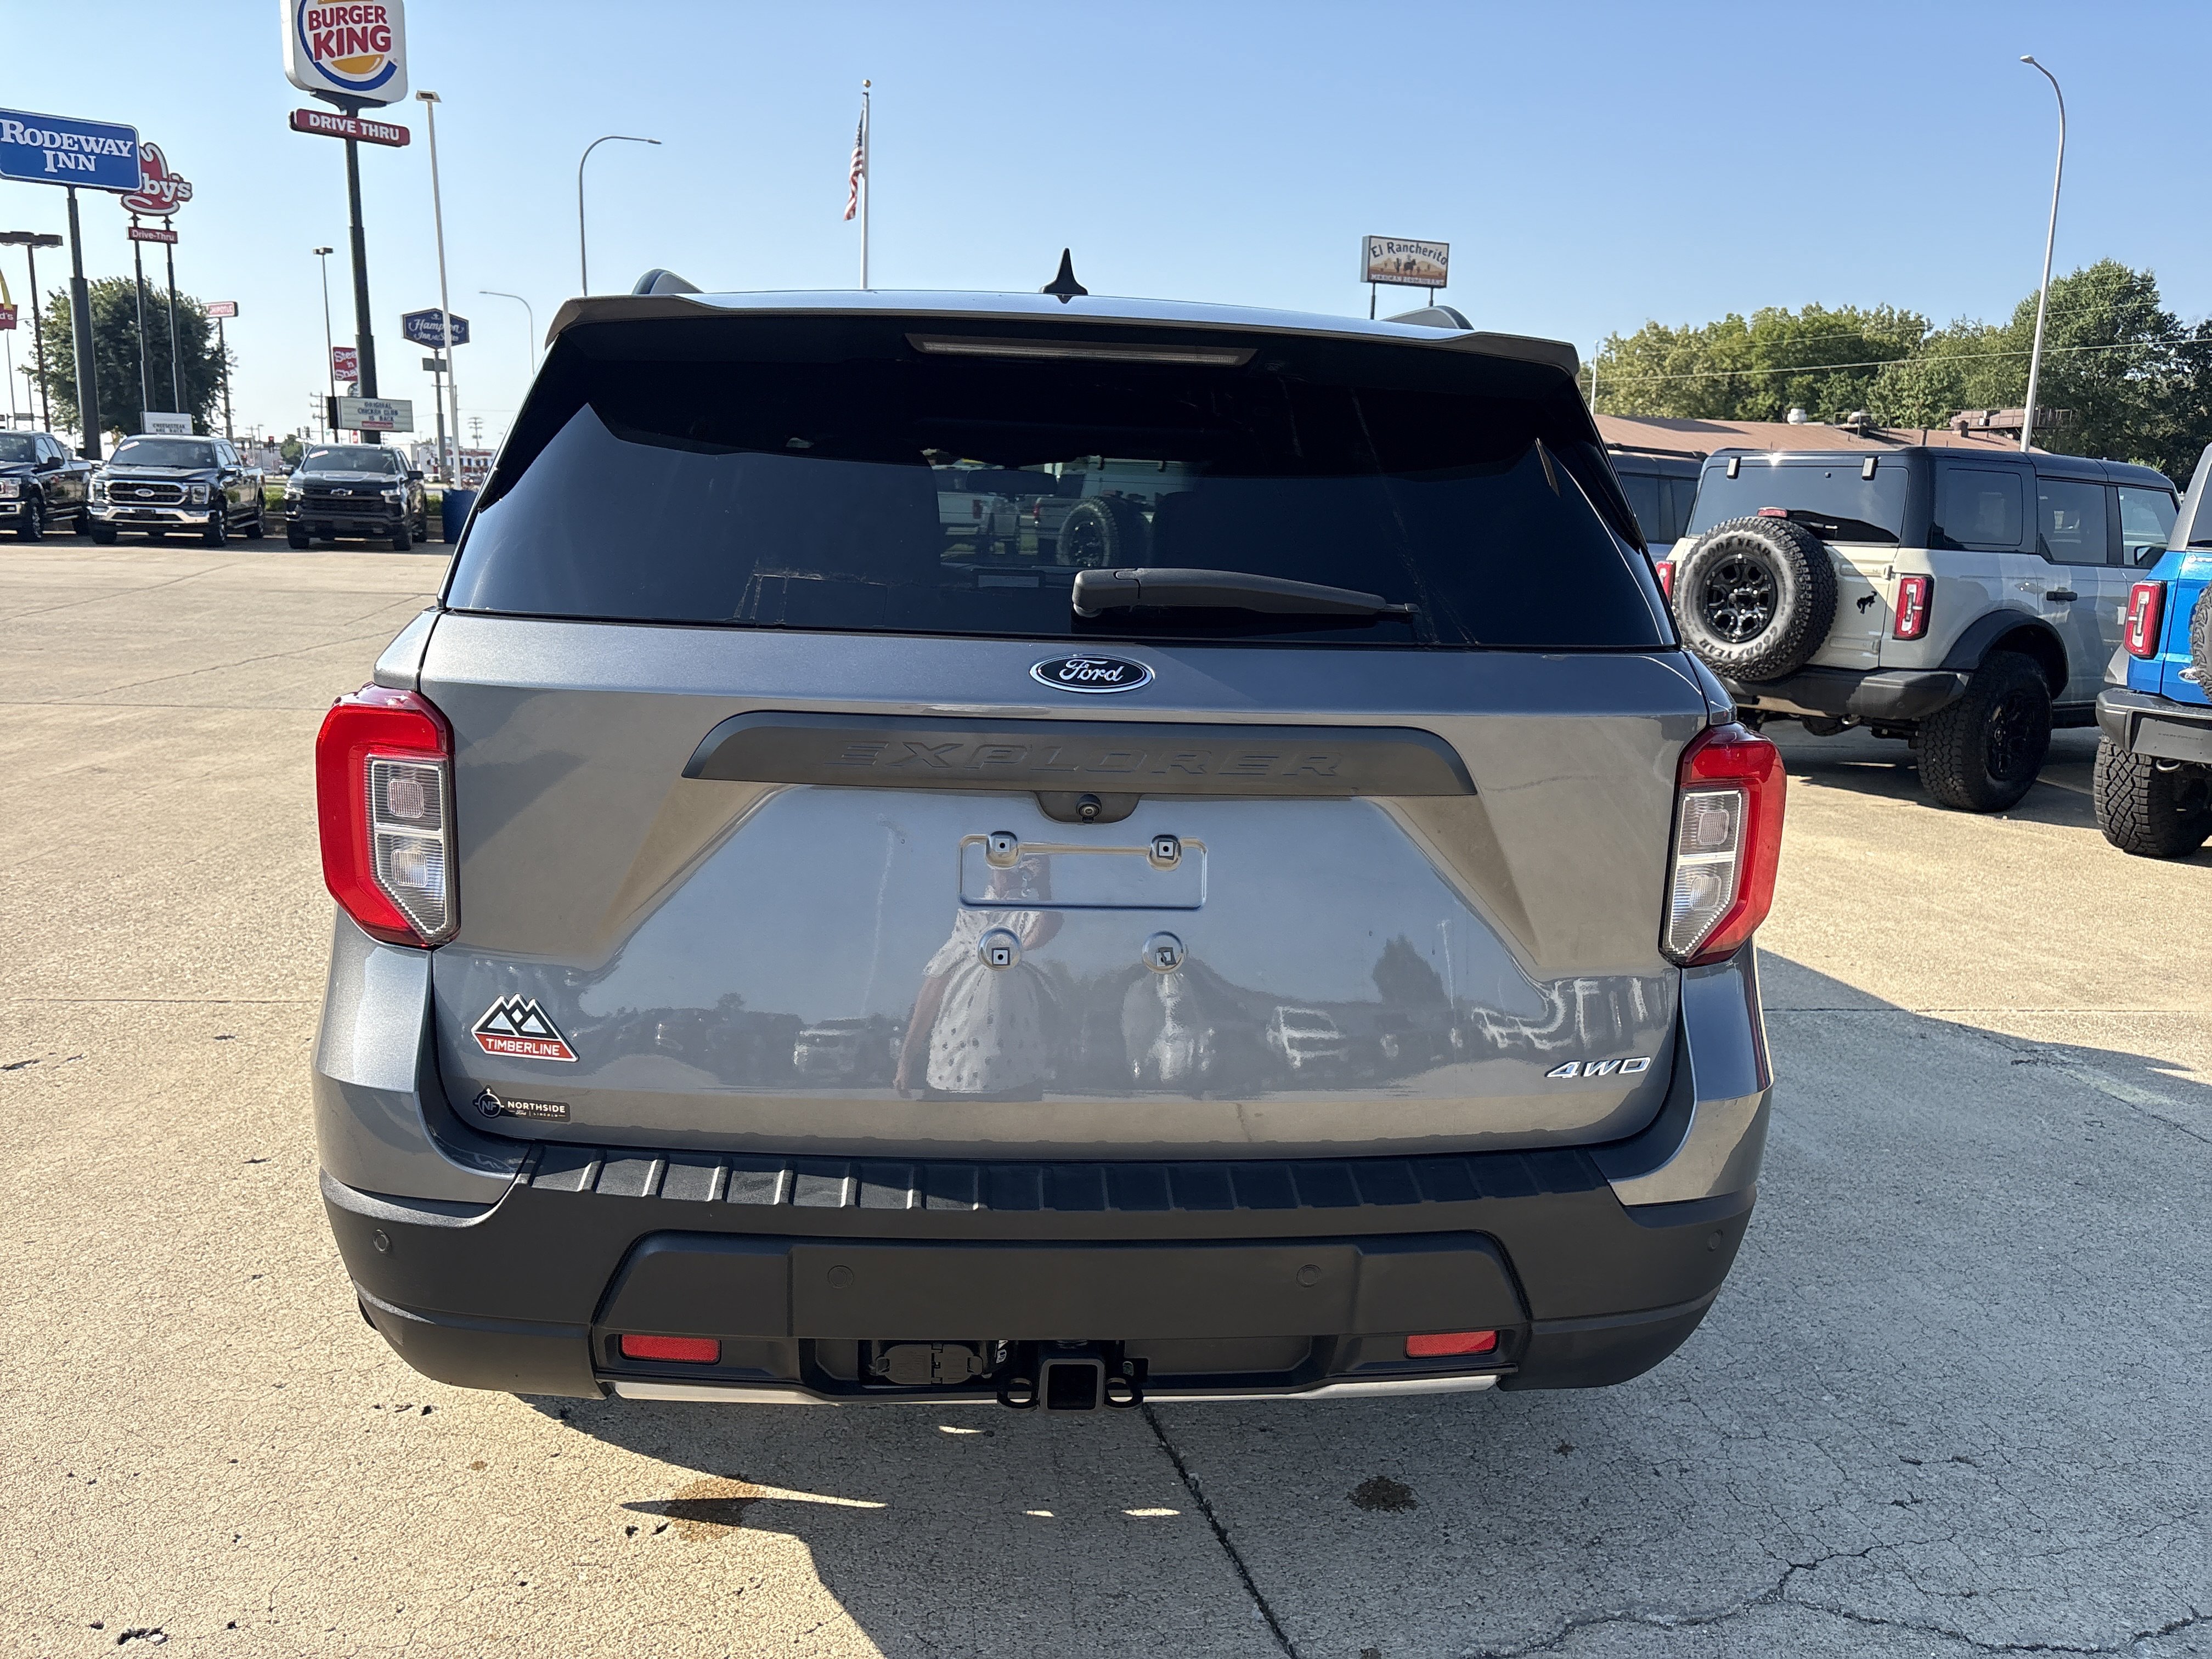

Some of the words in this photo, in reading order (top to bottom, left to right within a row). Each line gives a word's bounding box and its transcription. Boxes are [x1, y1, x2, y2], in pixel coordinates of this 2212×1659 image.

[308, 5, 387, 31] BURGER
[314, 25, 391, 61] KING
[1, 119, 133, 157] RODEWAY
[309, 114, 357, 133] DRIVE
[359, 122, 400, 140] THRU
[43, 150, 96, 172] INN
[142, 173, 191, 202] by's
[132, 229, 174, 241] Drive-Thru
[1371, 244, 1383, 258] El
[1387, 241, 1446, 265] Rancherito
[1059, 659, 1125, 681] Ford
[822, 739, 1343, 777] EXPLORER
[486, 1038, 560, 1056] TIMBERLINE
[1544, 1056, 1651, 1078] 4WD
[507, 1101, 566, 1113] NORTHSIDE
